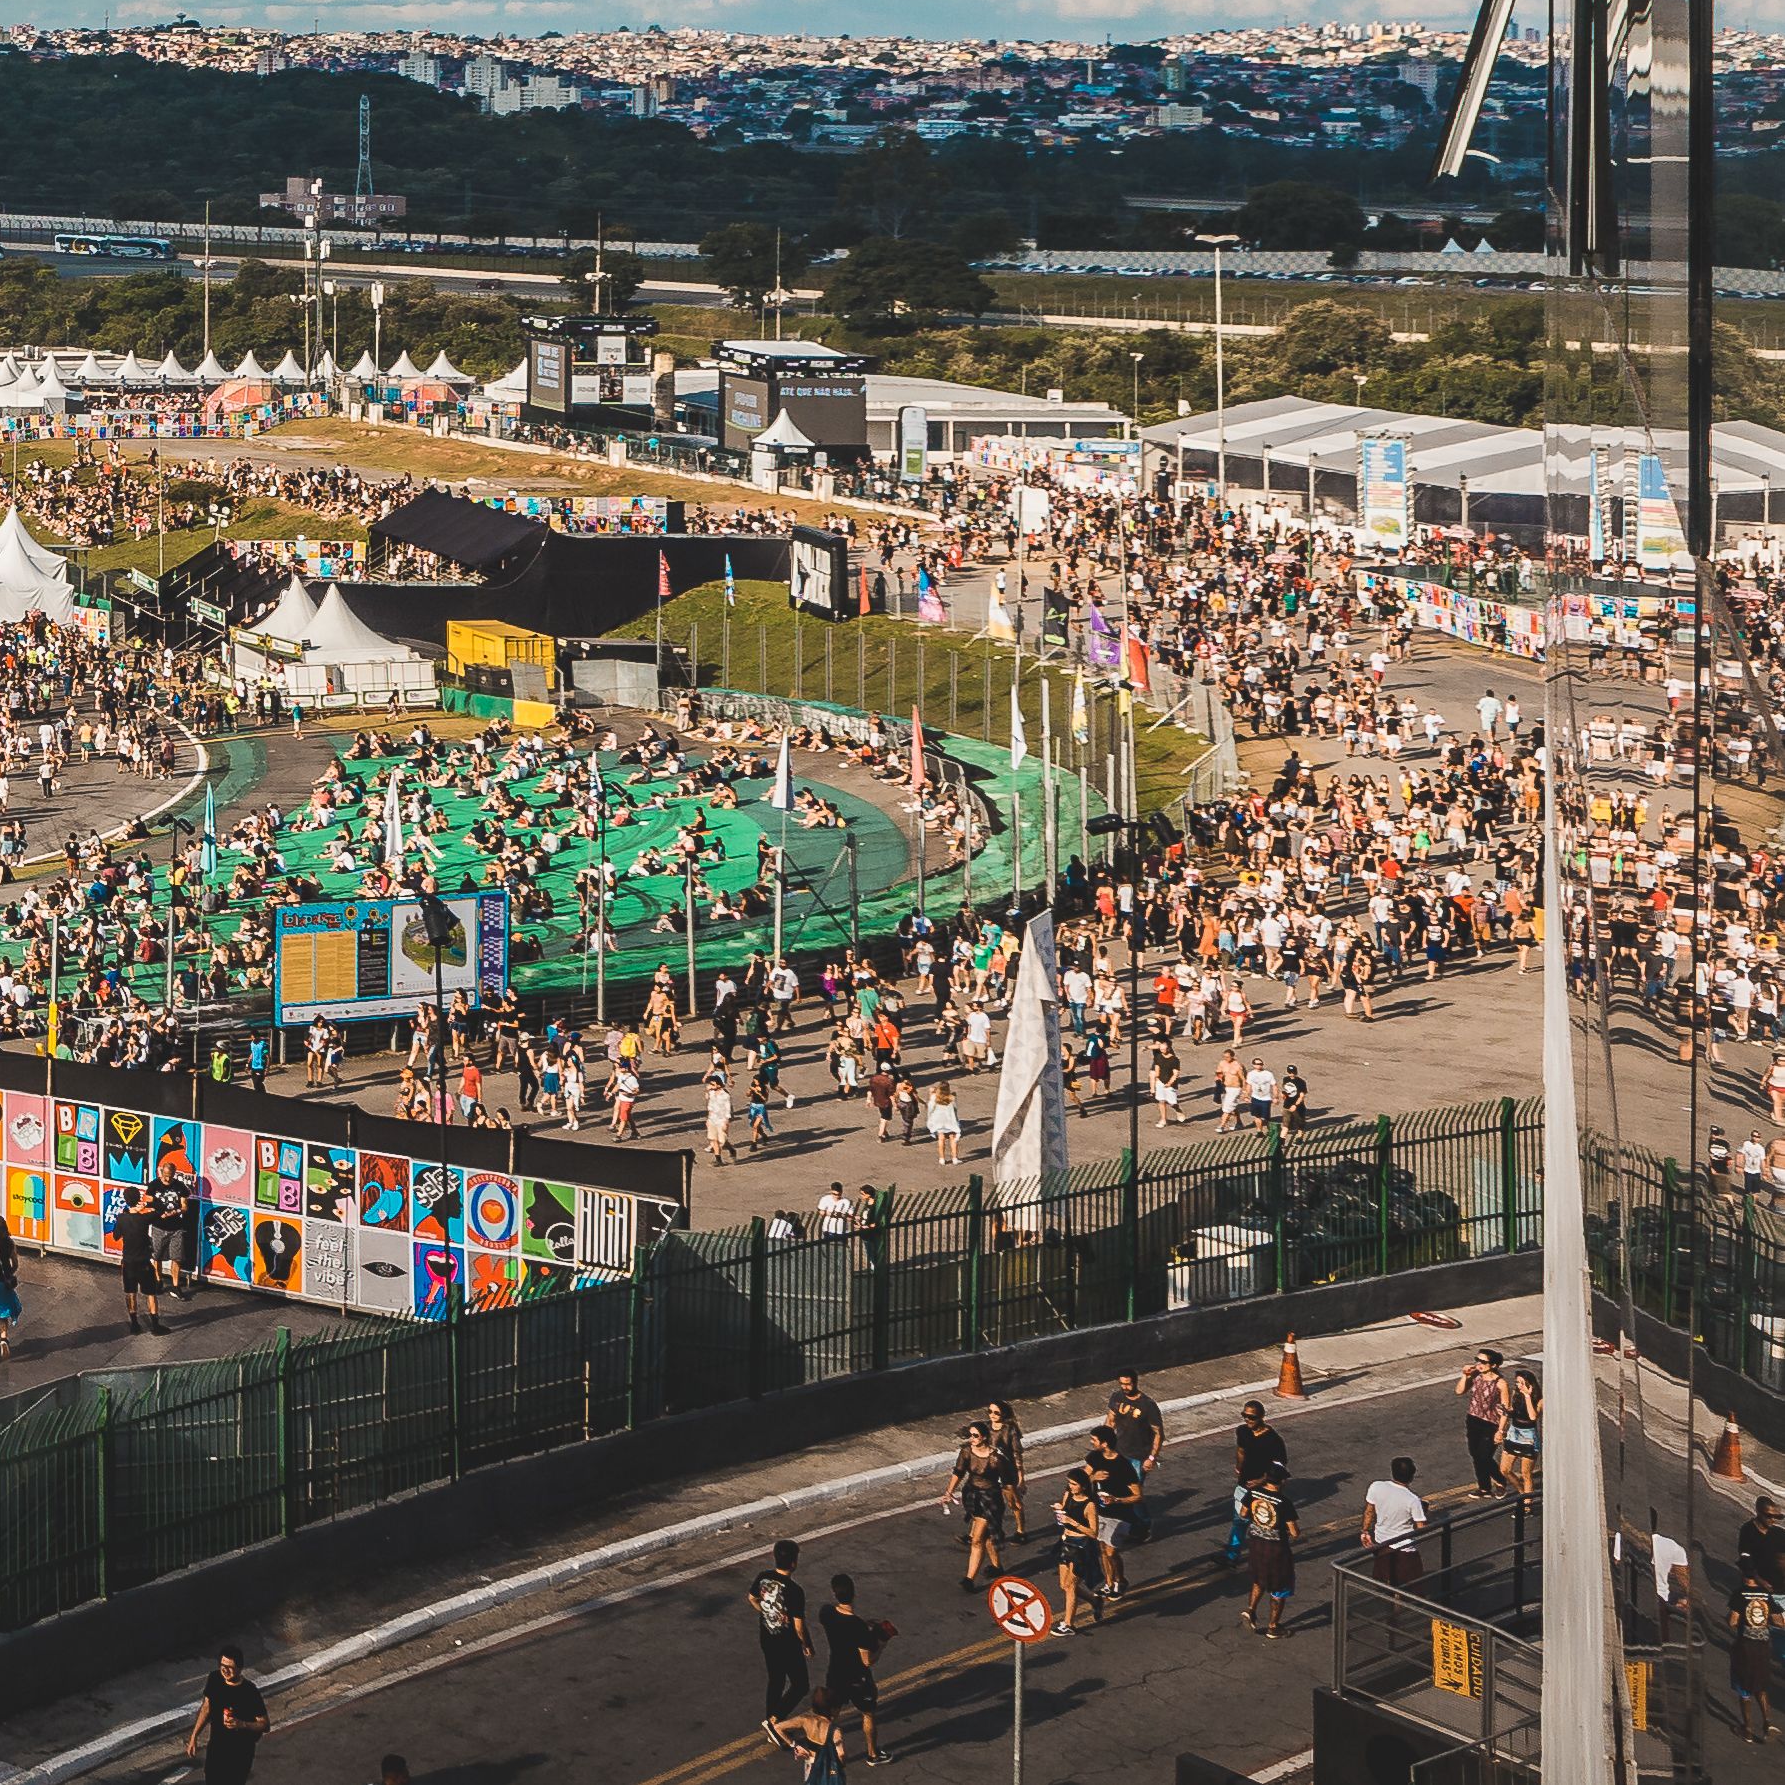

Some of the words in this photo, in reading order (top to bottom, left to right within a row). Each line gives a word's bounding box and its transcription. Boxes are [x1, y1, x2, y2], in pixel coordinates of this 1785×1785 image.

[59, 1106, 97, 1138] BR
[259, 1141, 300, 1175] BR
[316, 1234, 344, 1251] feel
[580, 1190, 628, 1268] HIGH
[315, 1271, 345, 1288] vibe
